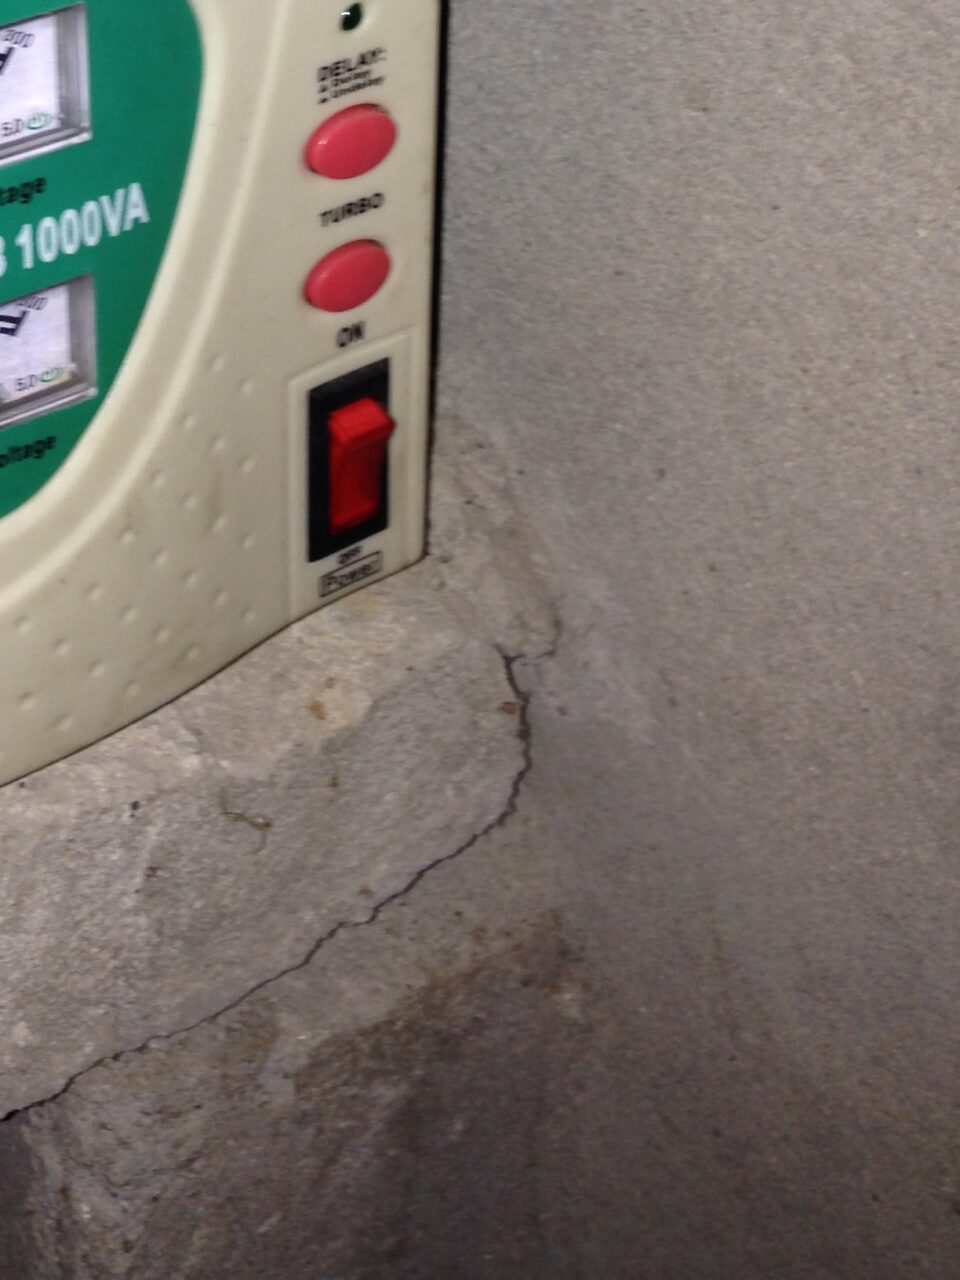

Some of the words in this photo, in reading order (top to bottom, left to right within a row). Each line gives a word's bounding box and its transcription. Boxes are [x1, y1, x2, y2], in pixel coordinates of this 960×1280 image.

[14, 182, 150, 270] 1000VA
[319, 192, 385, 227] TURBO
[336, 320, 365, 348] ON
